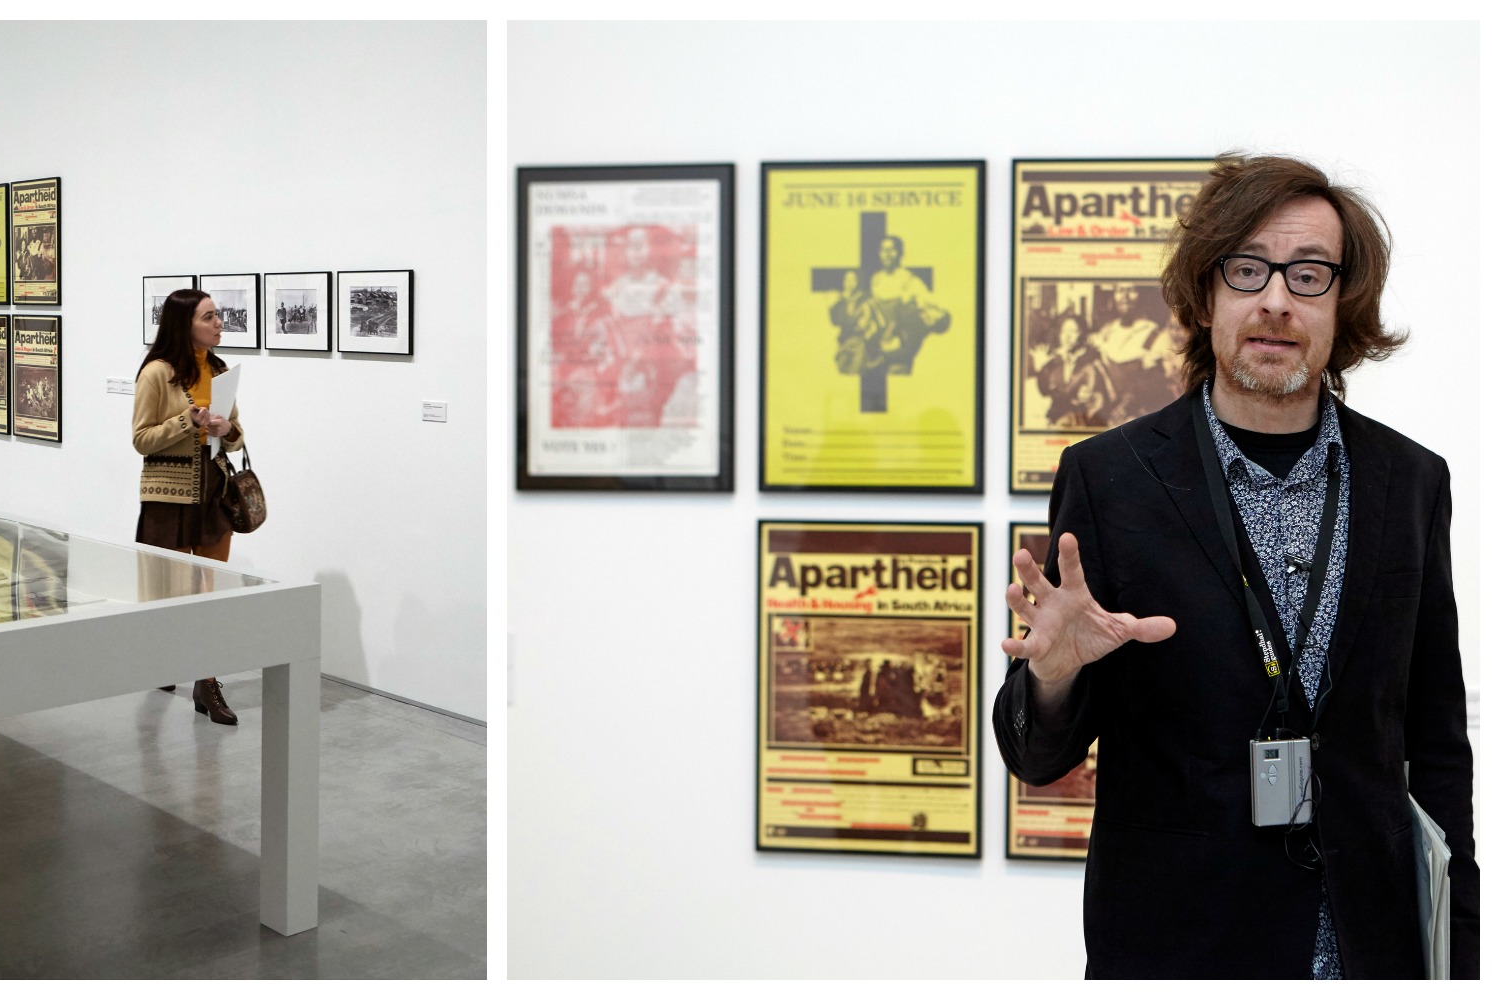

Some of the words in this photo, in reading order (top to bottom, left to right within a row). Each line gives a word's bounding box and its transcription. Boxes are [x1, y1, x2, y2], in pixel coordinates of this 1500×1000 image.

[13, 187, 56, 206] Apartheid
[783, 191, 840, 208] JUNE
[848, 191, 869, 208] 16
[871, 189, 963, 207] SERVICE
[1022, 184, 1195, 225] Aparthe
[15, 331, 57, 346] Apartheid
[769, 556, 972, 596] Apartheid
[877, 600, 889, 610] in
[892, 600, 929, 611] South
[933, 601, 973, 611] Africa
